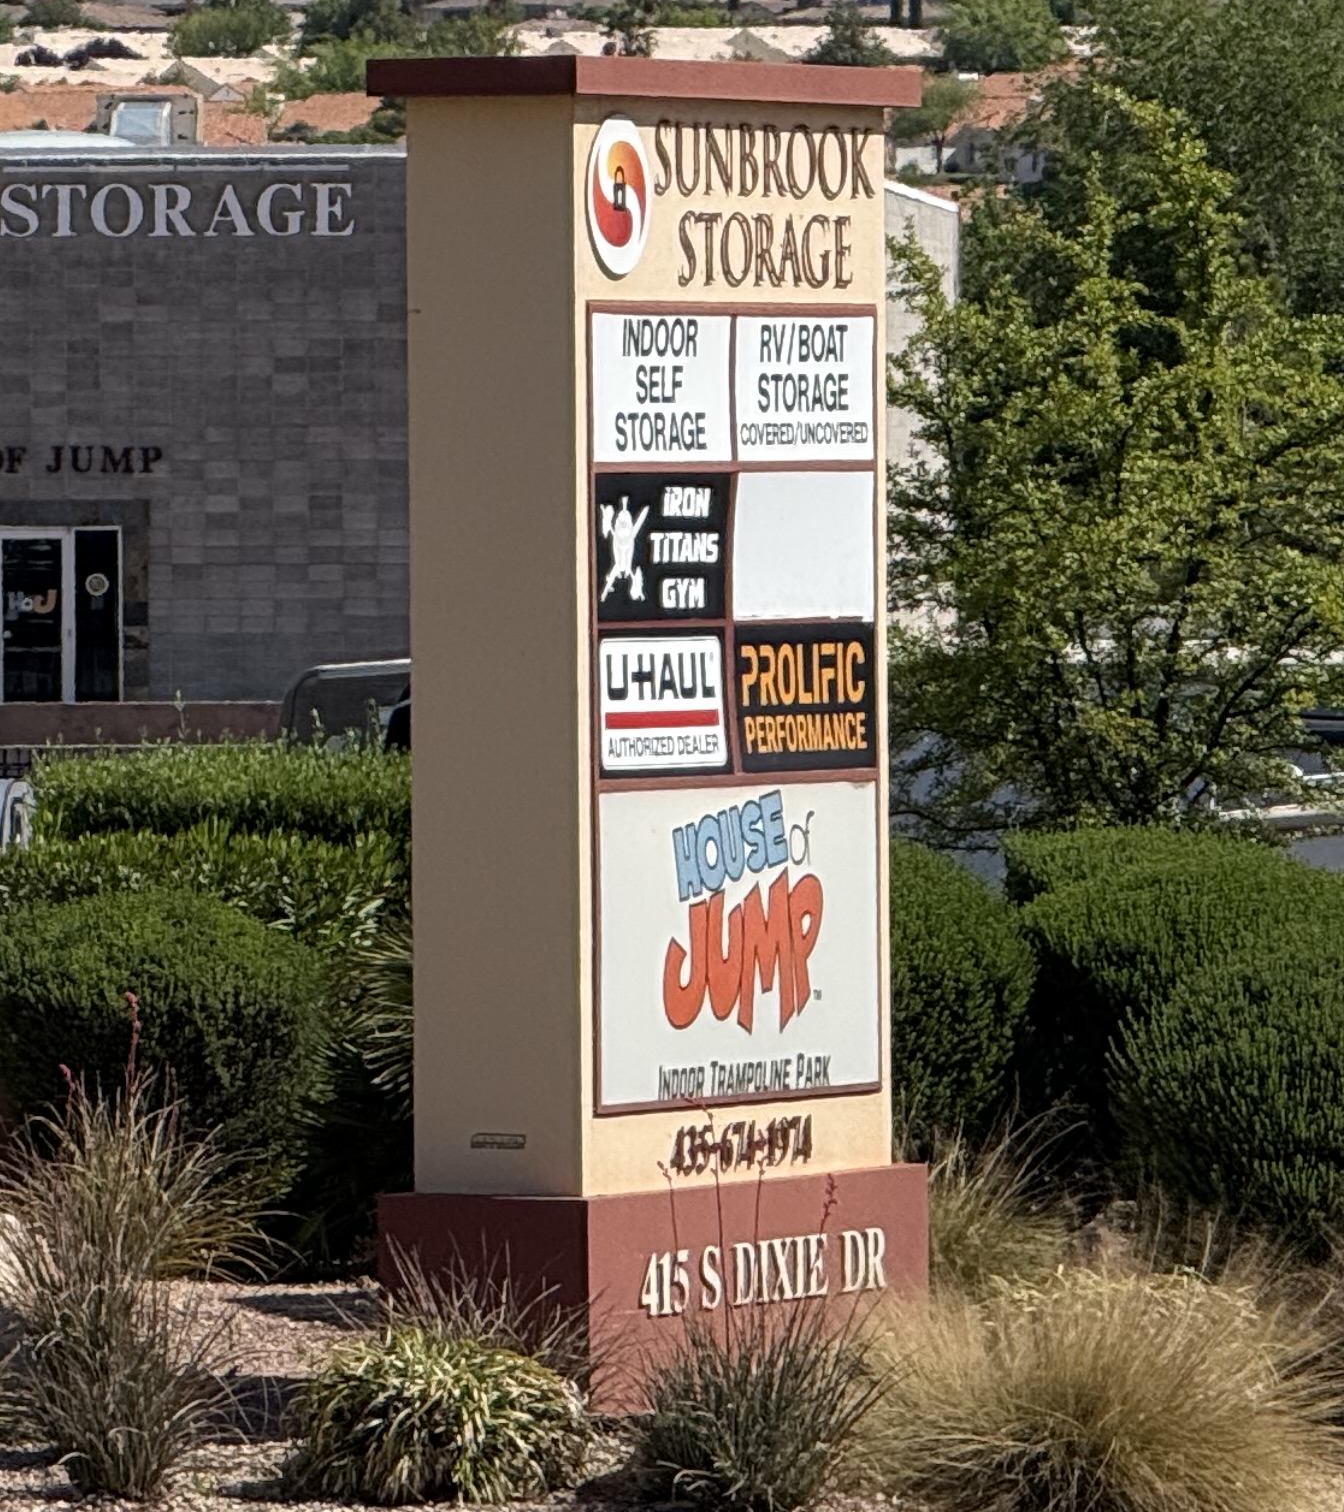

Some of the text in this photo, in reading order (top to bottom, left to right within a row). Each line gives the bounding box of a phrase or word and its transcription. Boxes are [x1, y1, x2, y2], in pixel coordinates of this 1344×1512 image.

[653, 119, 876, 200] SUNBROOK
[677, 210, 854, 289] STORAGE
[621, 318, 699, 358] INDOOR
[759, 323, 849, 366] RV/BOAT
[634, 365, 684, 404] SELF
[756, 373, 849, 413] STORAGE
[614, 411, 708, 452] STORAGE
[740, 421, 868, 445] COVERED/UNCOVERED
[45, 445, 162, 473] JUMP
[662, 577, 706, 609] GYM
[606, 651, 716, 701] U-HAUL
[741, 640, 866, 707] PROLIFIC
[608, 733, 720, 758] AUTHORIZED DEALER
[743, 711, 868, 754] PERFORMANCE
[672, 789, 789, 902] HOUSE
[663, 867, 824, 1036] JUMP
[669, 1113, 813, 1176] 435-674-1974
[640, 1226, 888, 1317] 415 S DIXIE DR
